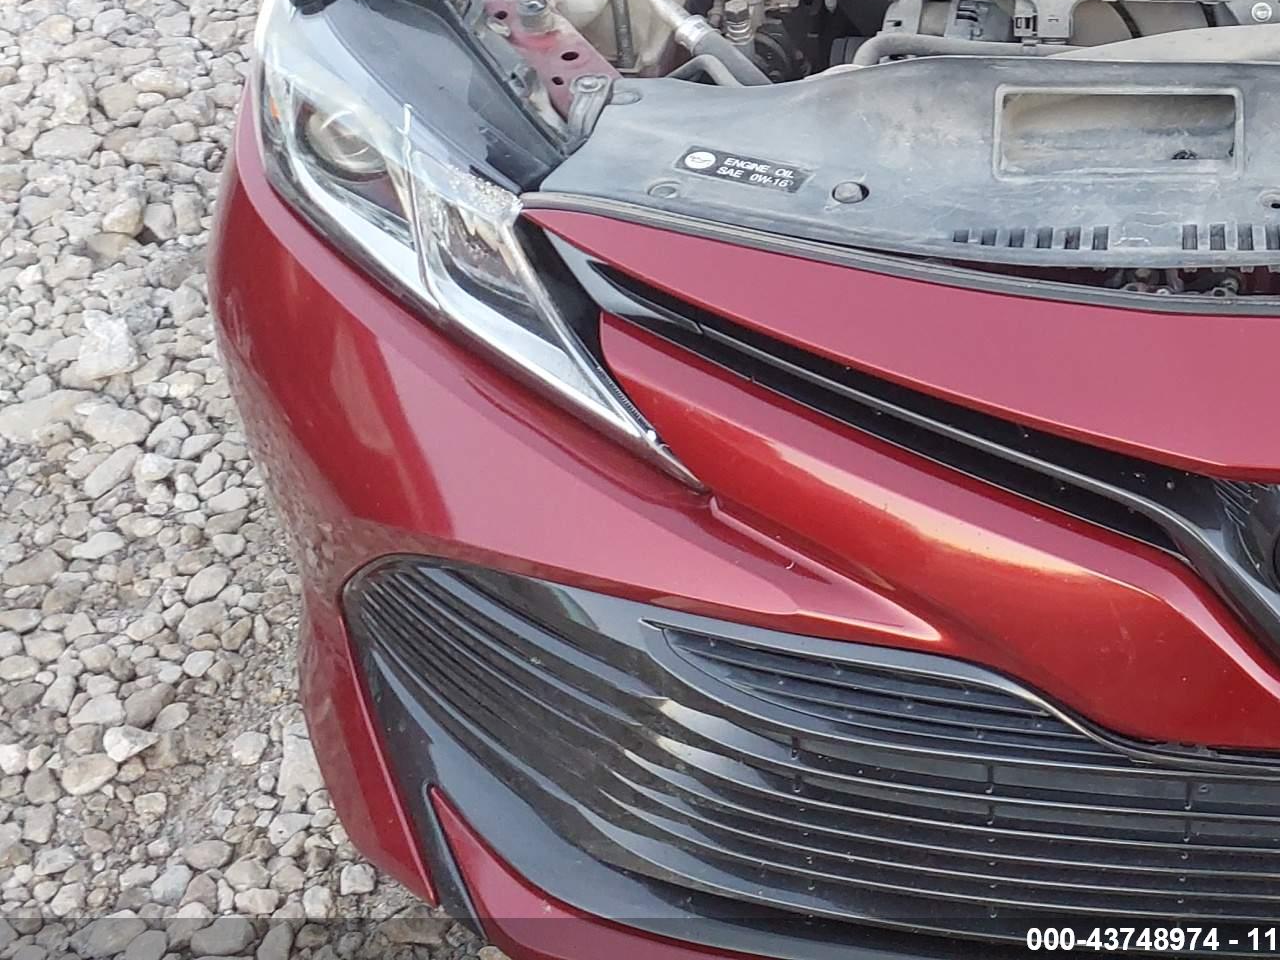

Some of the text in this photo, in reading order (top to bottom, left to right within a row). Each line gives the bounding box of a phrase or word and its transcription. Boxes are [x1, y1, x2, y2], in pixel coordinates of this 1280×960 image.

[716, 166, 790, 188] SAE 0W-16
[723, 157, 795, 179] ENGINE OIL
